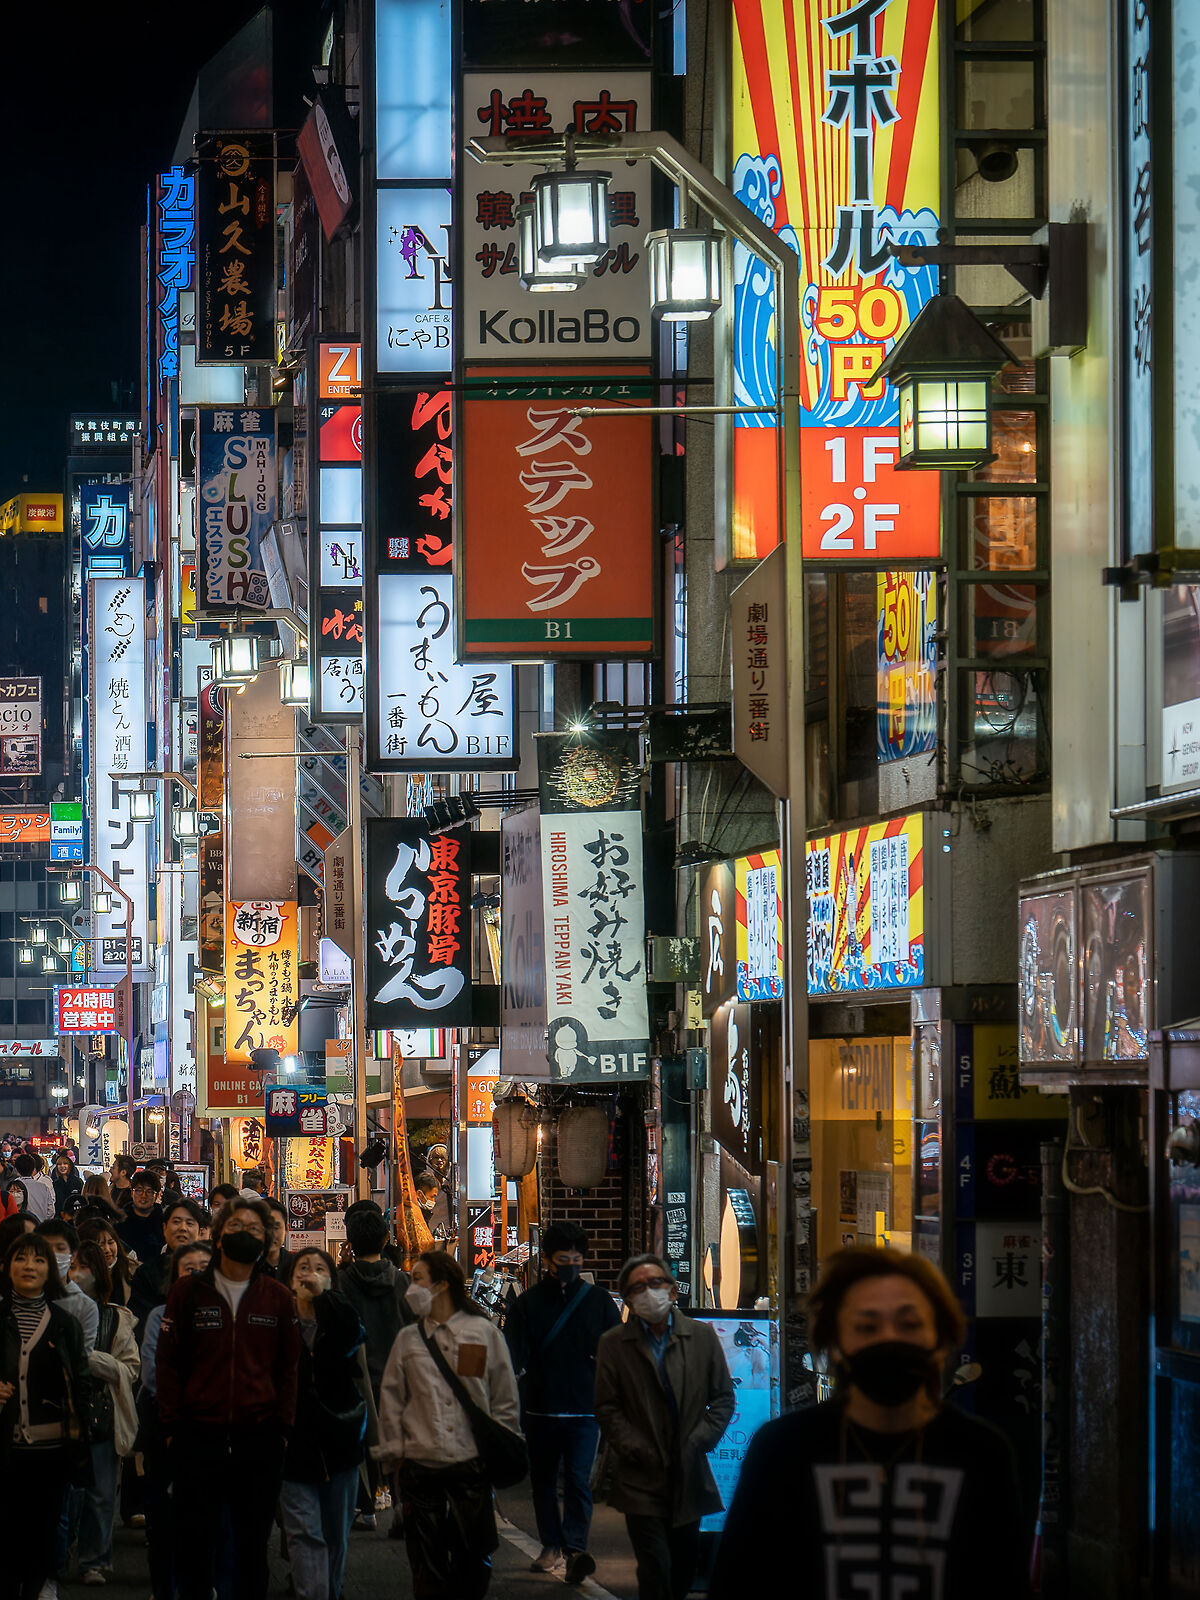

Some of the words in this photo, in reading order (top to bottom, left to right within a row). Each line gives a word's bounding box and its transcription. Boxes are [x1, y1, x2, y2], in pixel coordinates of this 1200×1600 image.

[217, 183, 254, 337] 山久農場
[415, 314, 441, 323] CAFE
[479, 309, 640, 344] KollaBo
[817, 287, 900, 341] 50
[224, 345, 250, 357] 5F
[212, 411, 262, 433] 麻雀
[321, 408, 334, 417] 4F
[824, 436, 900, 483] 1F
[226, 438, 250, 600] SLUSH
[515, 407, 602, 612] ステップ
[819, 503, 900, 550] 2F
[209, 509, 223, 600] エスラッシュ
[545, 622, 573, 639] B1
[410, 586, 459, 755] うまいもん
[747, 602, 770, 742] 劇場通り一番街
[456, 673, 504, 716] 屋
[386, 693, 409, 756] 一番街
[466, 735, 509, 755] B1F
[550, 831, 568, 907] HIROSHIMA
[332, 855, 346, 930] 劇場通り一番街
[427, 835, 461, 966] 東京豚骨
[236, 911, 279, 935] 新宿
[578, 829, 642, 1020] お好み焼き
[554, 915, 573, 1006] TEPPANYAKI
[62, 993, 115, 1009] 24時間
[62, 1012, 114, 1028] 営業中
[234, 948, 267, 1051] まっちゃん
[10, 1041, 42, 1055] クール
[600, 1053, 647, 1074] B1F
[214, 1081, 248, 1091] ONLINE
[237, 1095, 248, 1104] B1
[300, 1093, 327, 1103] フリー
